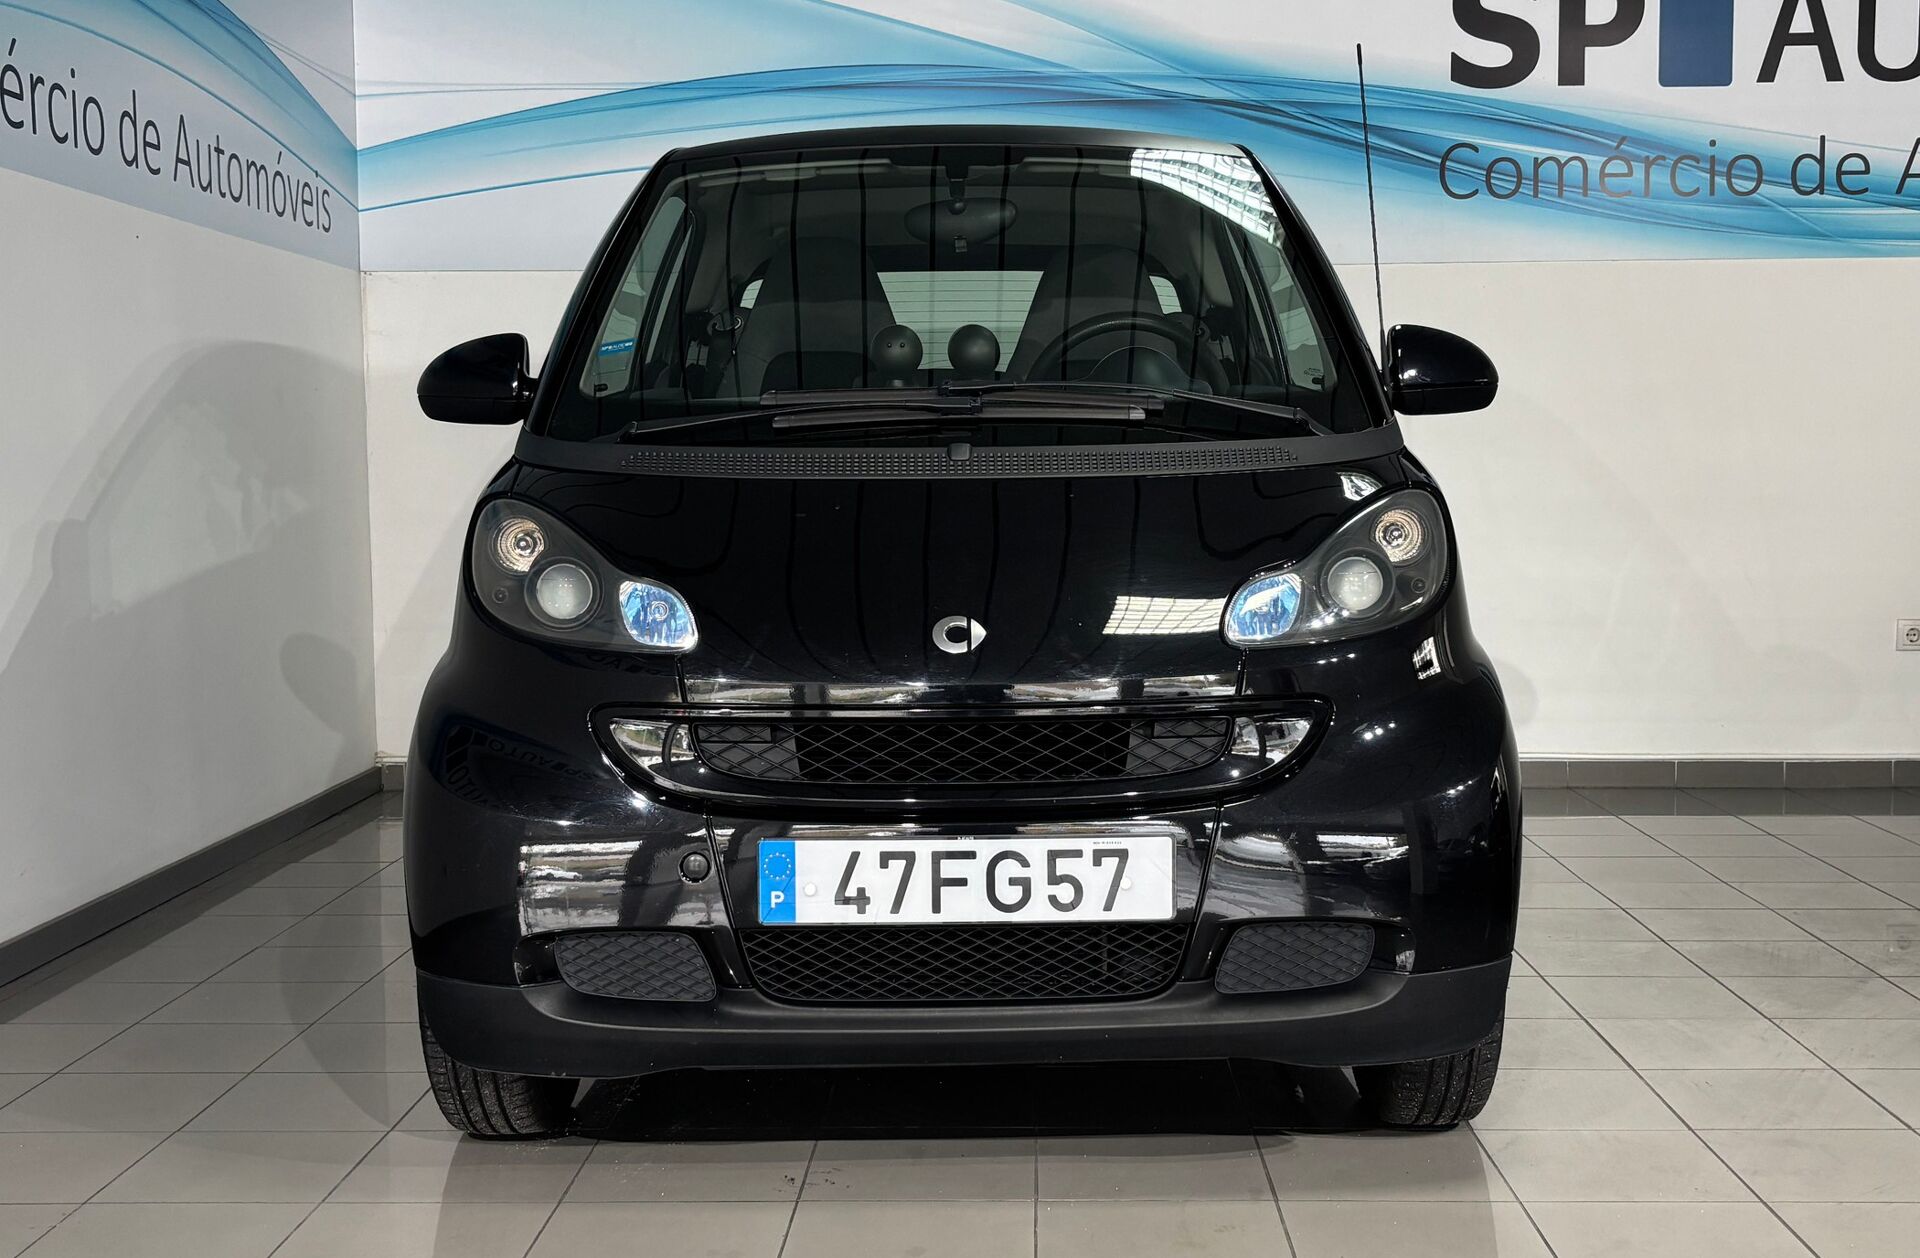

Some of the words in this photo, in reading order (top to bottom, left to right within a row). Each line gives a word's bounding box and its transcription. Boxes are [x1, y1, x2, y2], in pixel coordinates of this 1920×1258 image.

[119, 89, 161, 176] de
[173, 114, 332, 233] Automóveis
[1439, 136, 1763, 200] Comércio
[1790, 135, 1871, 196] de
[770, 890, 785, 909] P
